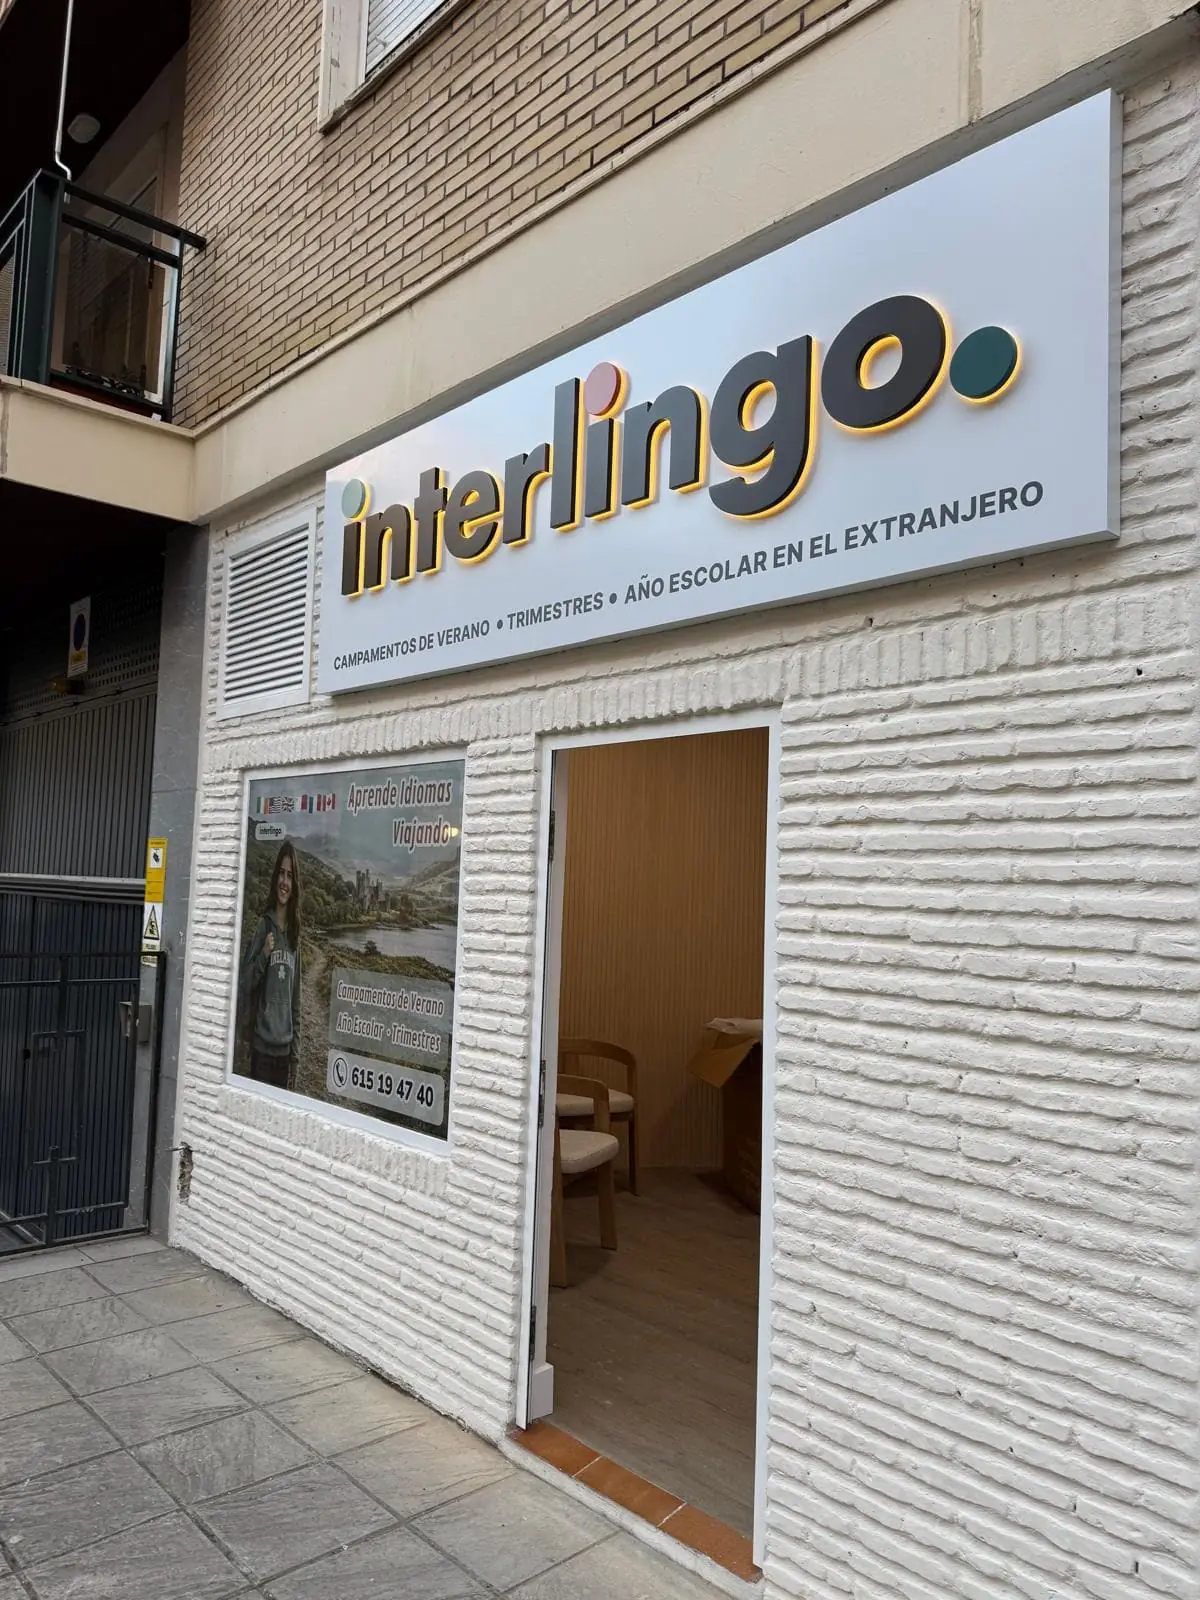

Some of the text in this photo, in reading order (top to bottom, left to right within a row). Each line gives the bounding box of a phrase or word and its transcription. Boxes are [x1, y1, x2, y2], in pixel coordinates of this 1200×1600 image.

[333, 480, 1044, 671] CAMPAMENTOS DE VERANO TRIMESTRES AÑO ESCOLAR EN EL EXTRANJERO
[347, 777, 452, 815] Aprende Idiomas
[393, 817, 450, 852] Viajando
[337, 981, 444, 1017] Campamentos de Verano
[336, 1012, 441, 1053] Año Escolar Trimestres
[351, 1067, 434, 1107] 615 19 47 40
